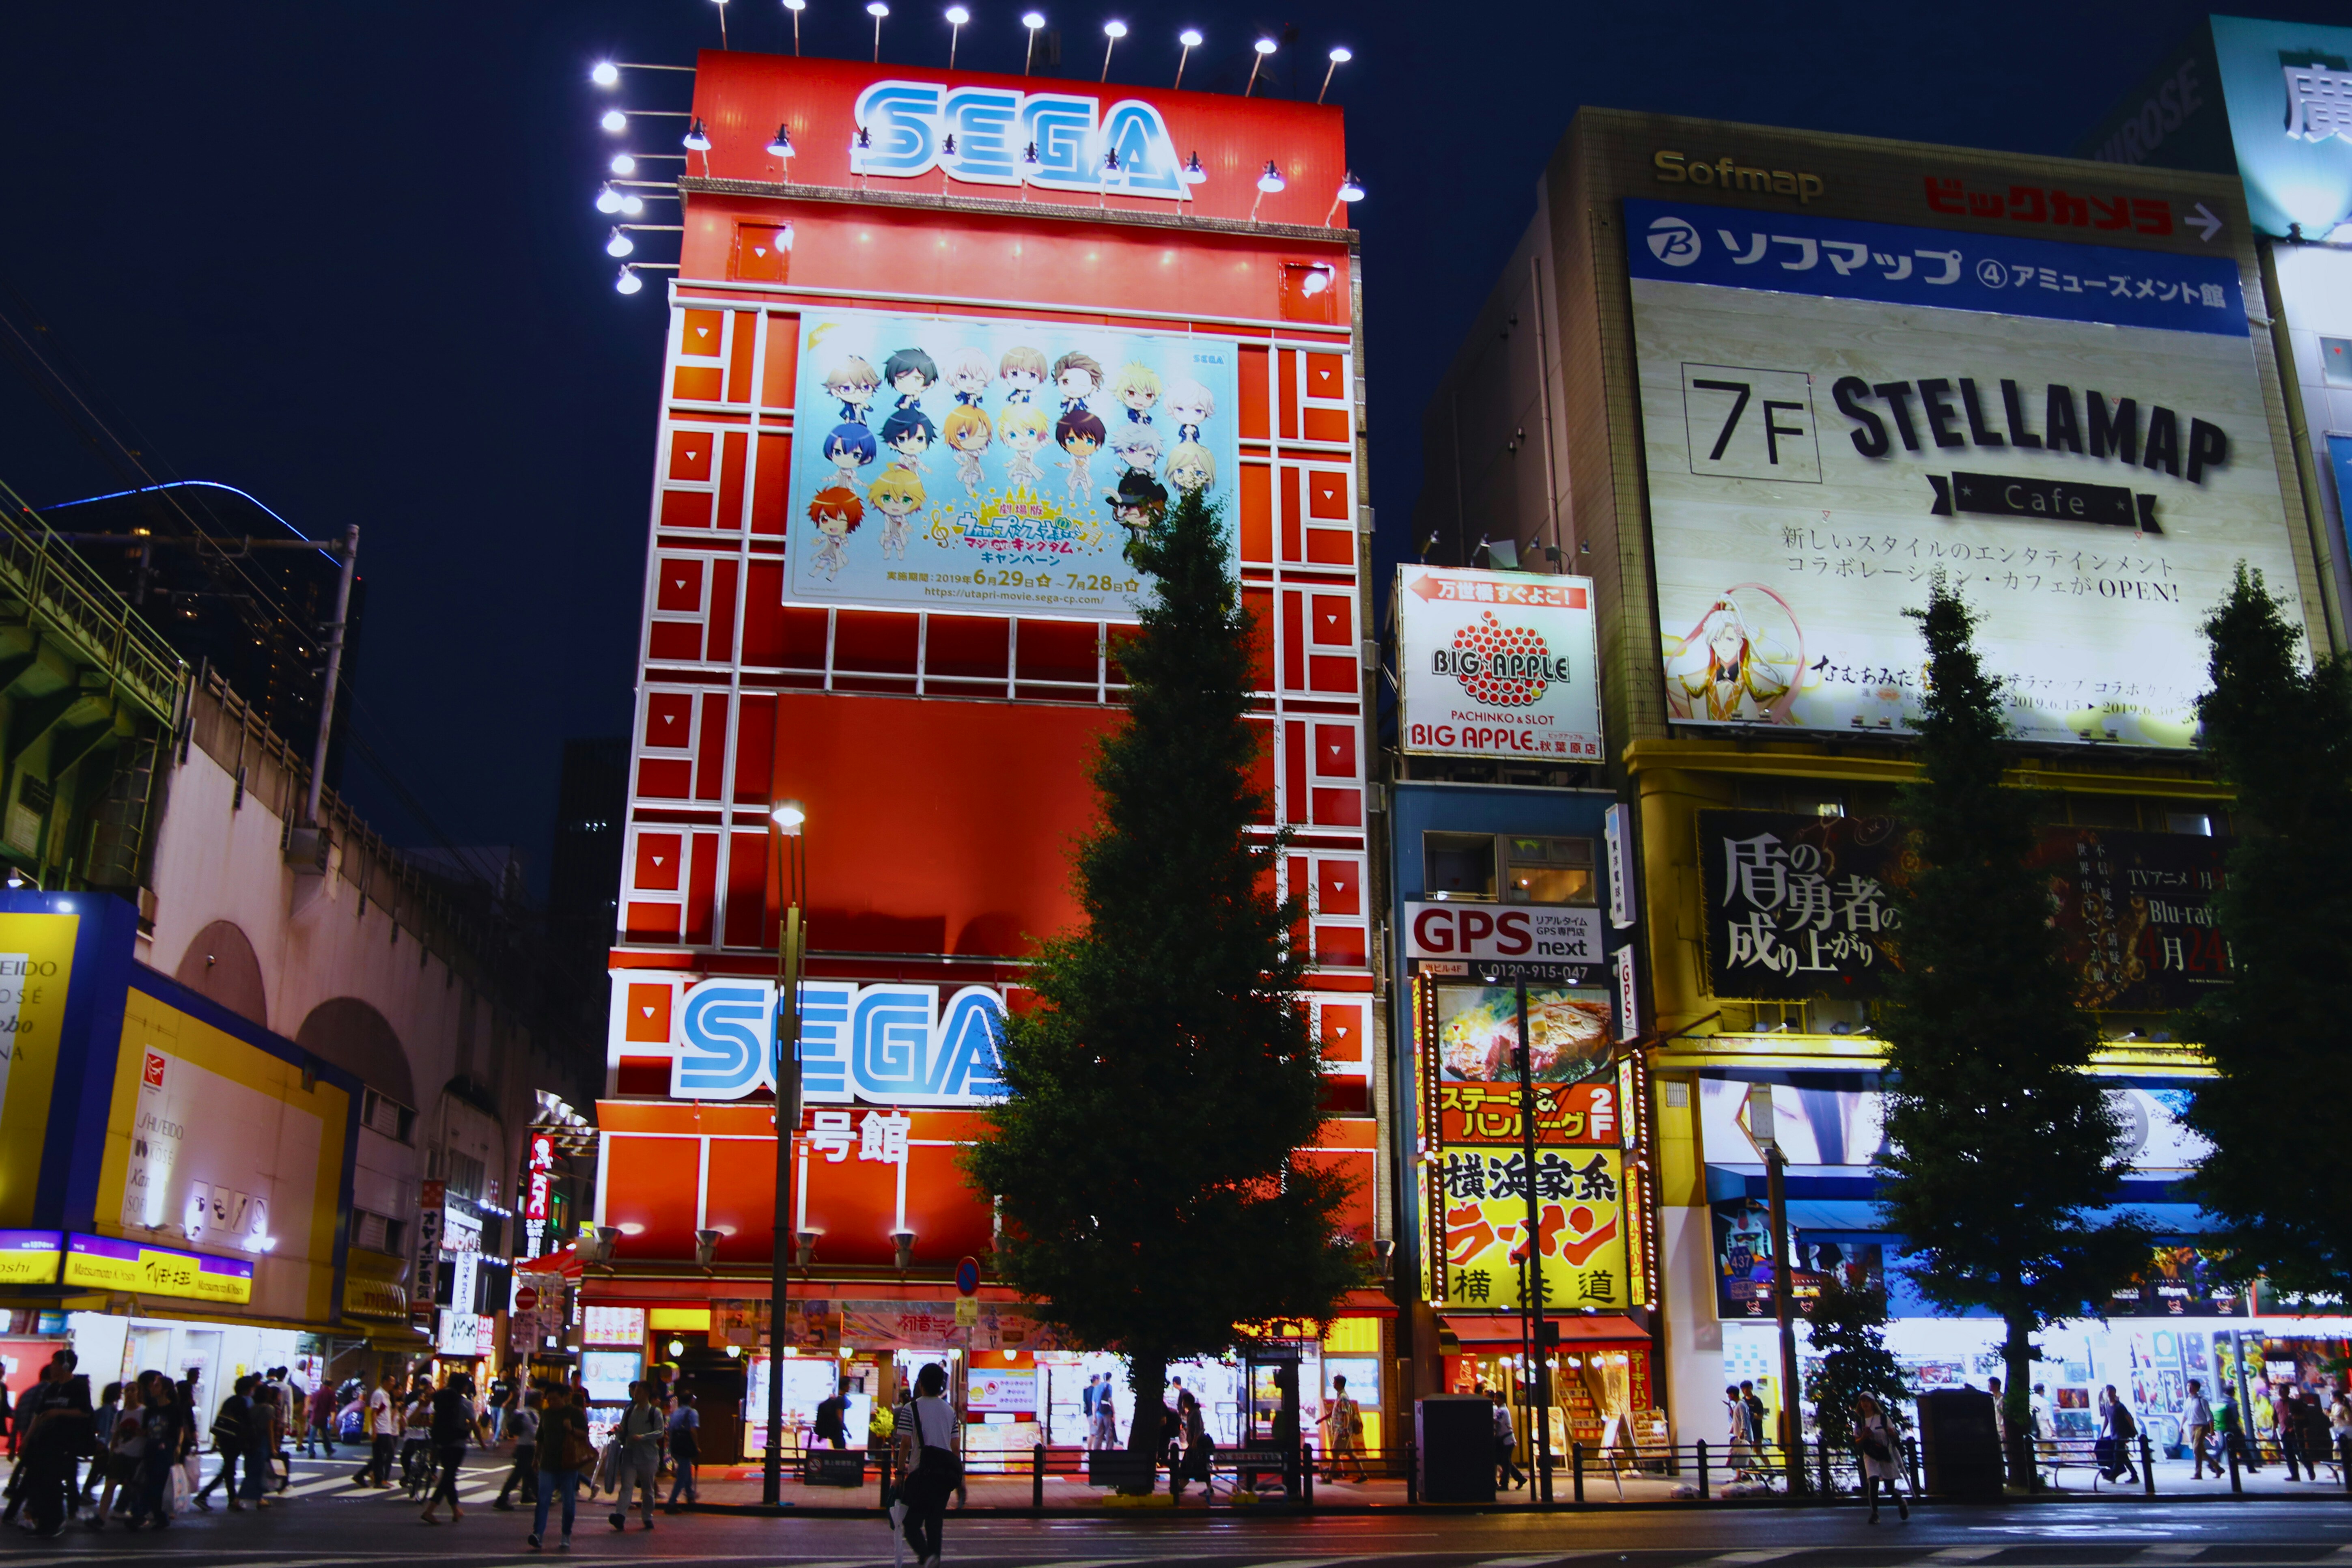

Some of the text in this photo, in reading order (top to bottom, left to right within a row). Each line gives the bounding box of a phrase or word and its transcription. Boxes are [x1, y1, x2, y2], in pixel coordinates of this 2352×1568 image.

[851, 80, 1192, 200] SEGA
[1654, 150, 1824, 204] Sofmap
[1924, 175, 2174, 235] ビックカメラ
[1717, 229, 1962, 284] ソフマップ
[1193, 354, 1225, 365] SEGA
[1693, 376, 2228, 485] 7F STELLAMAP
[999, 504, 1043, 516] 劇場版
[2003, 485, 2086, 515] Cafe
[981, 551, 1061, 566] キャンペーン
[1782, 526, 2174, 578] 新しいスタイルのエンタテインメント
[925, 587, 1105, 605] https://utapri-movie.sega-cp.com/
[2099, 578, 2180, 603] OPEN!
[1433, 648, 1570, 682] BIG APPLE
[1452, 711, 1514, 724] PACHINKO
[1525, 716, 1555, 726] SLOT
[2010, 696, 2081, 711] 2019.6.15
[1412, 724, 1455, 746] BIG
[1539, 740, 1596, 755] 秋葉原店
[1722, 832, 1902, 932] 盾の勇者の
[1536, 915, 1588, 927] リアルタイム
[2149, 900, 2213, 927] Blu-ray
[1413, 908, 1533, 956] GPS
[1726, 911, 1873, 978] 成り上がり
[1538, 939, 1587, 956] next
[1490, 963, 1588, 979] 0120-915-047
[1621, 964, 1632, 1019] GPS
[670, 978, 1017, 1106] SEGA
[137, 1113, 184, 1140] SHISEIDO
[1590, 1088, 1615, 1140] 2F
[529, 1172, 547, 1217] KFC
[416, 1211, 438, 1299] オヤイデ電気
[1731, 1255, 1751, 1268] 437
